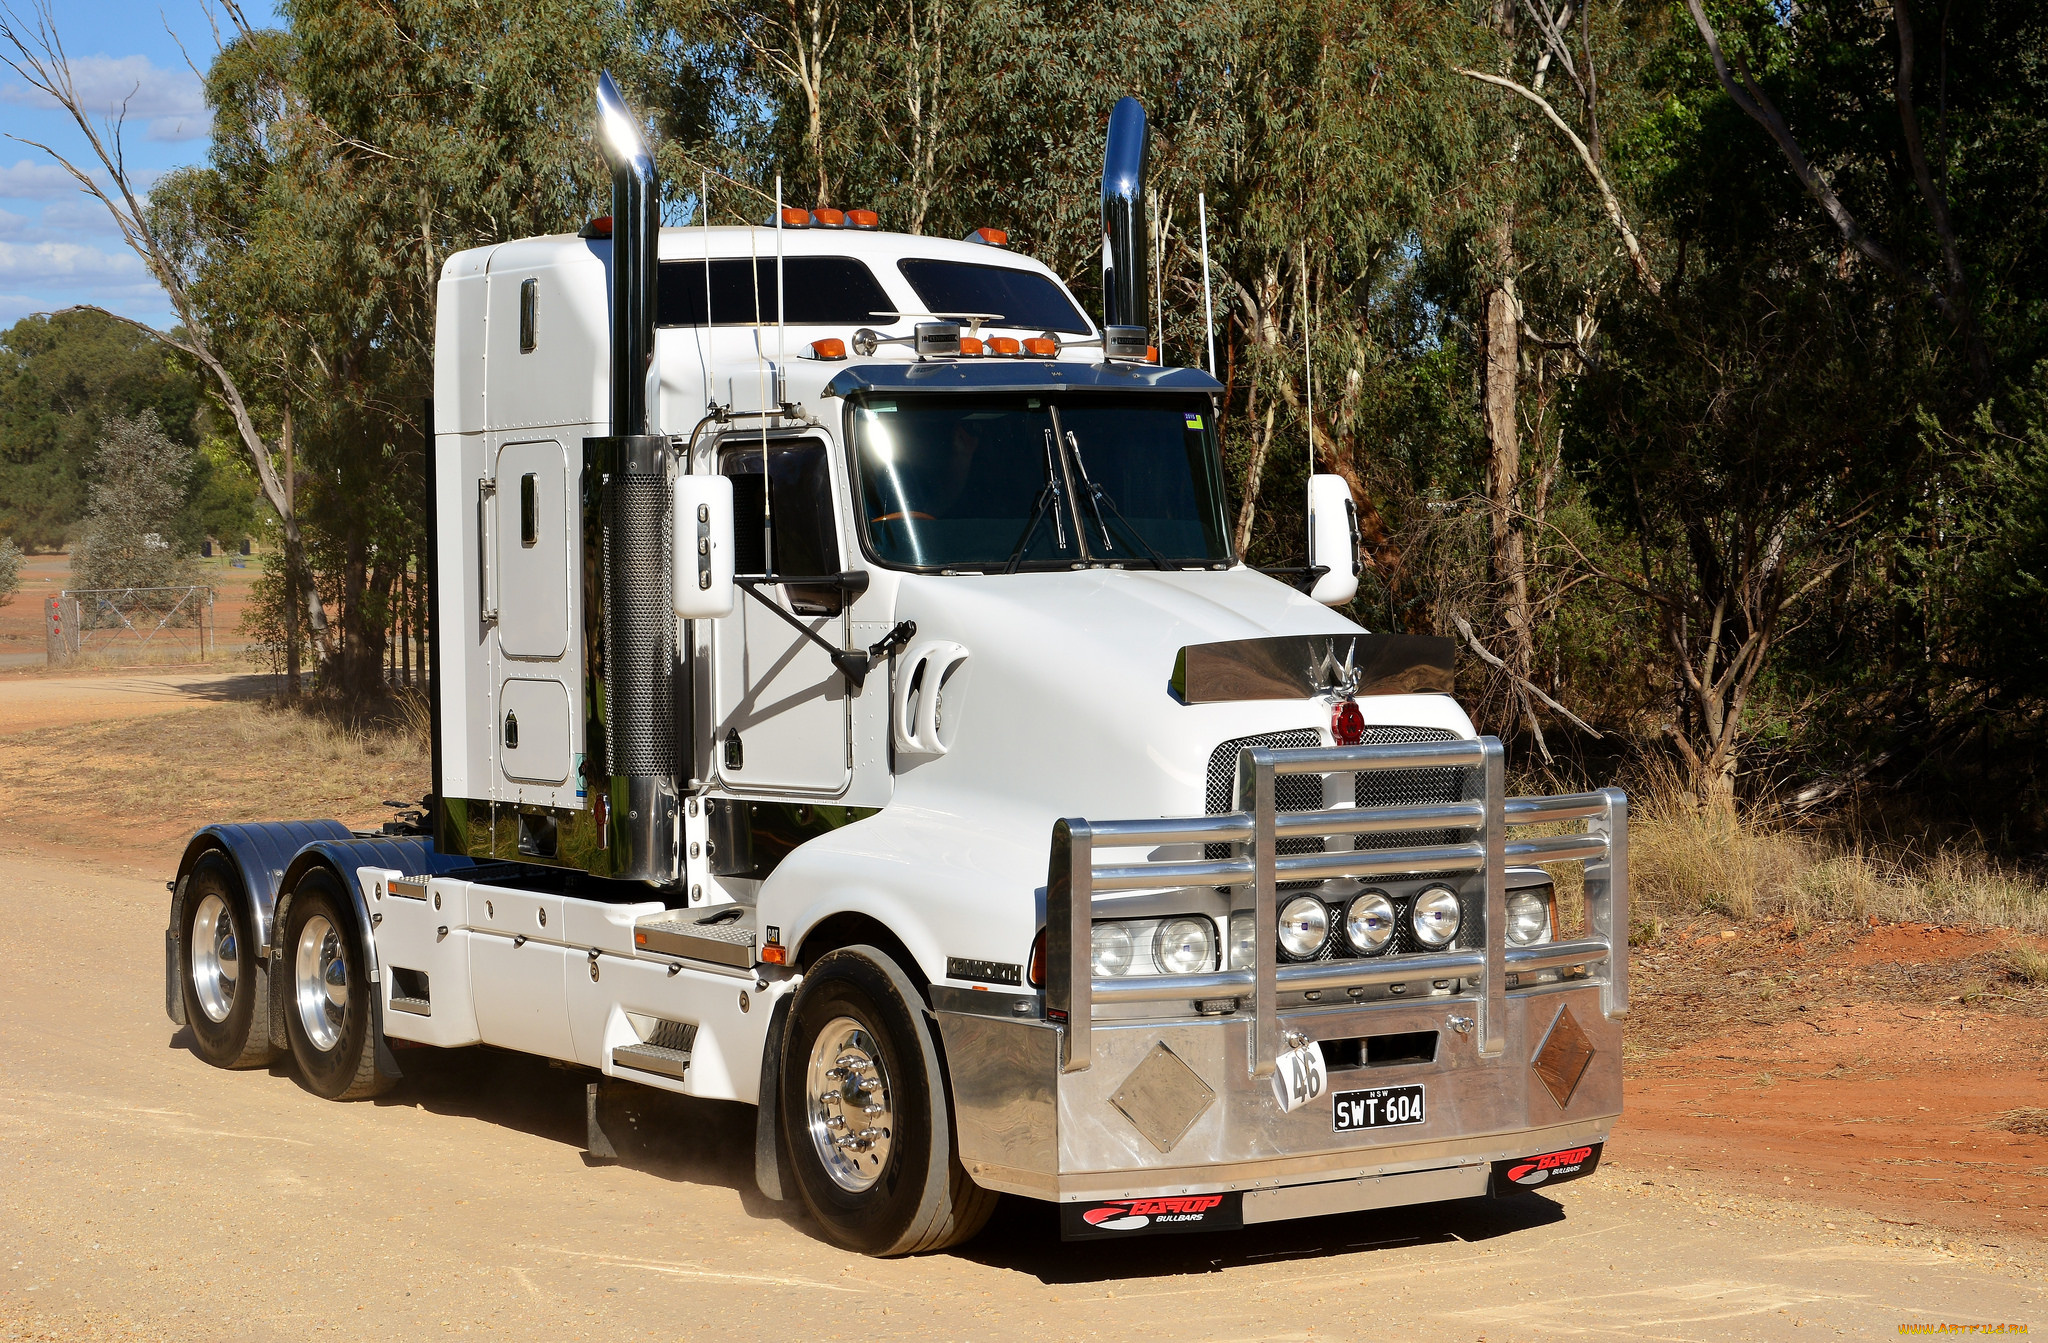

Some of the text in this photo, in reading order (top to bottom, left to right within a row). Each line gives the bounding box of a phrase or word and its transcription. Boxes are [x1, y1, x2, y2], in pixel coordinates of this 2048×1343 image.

[767, 928, 779, 942] CAT
[946, 957, 1021, 980] KENWORTH
[1292, 1051, 1321, 1103] 46
[1369, 1090, 1389, 1098] NSW
[1552, 1165, 1581, 1175] BULLBARS
[1155, 1214, 1204, 1222] BULLBARS
